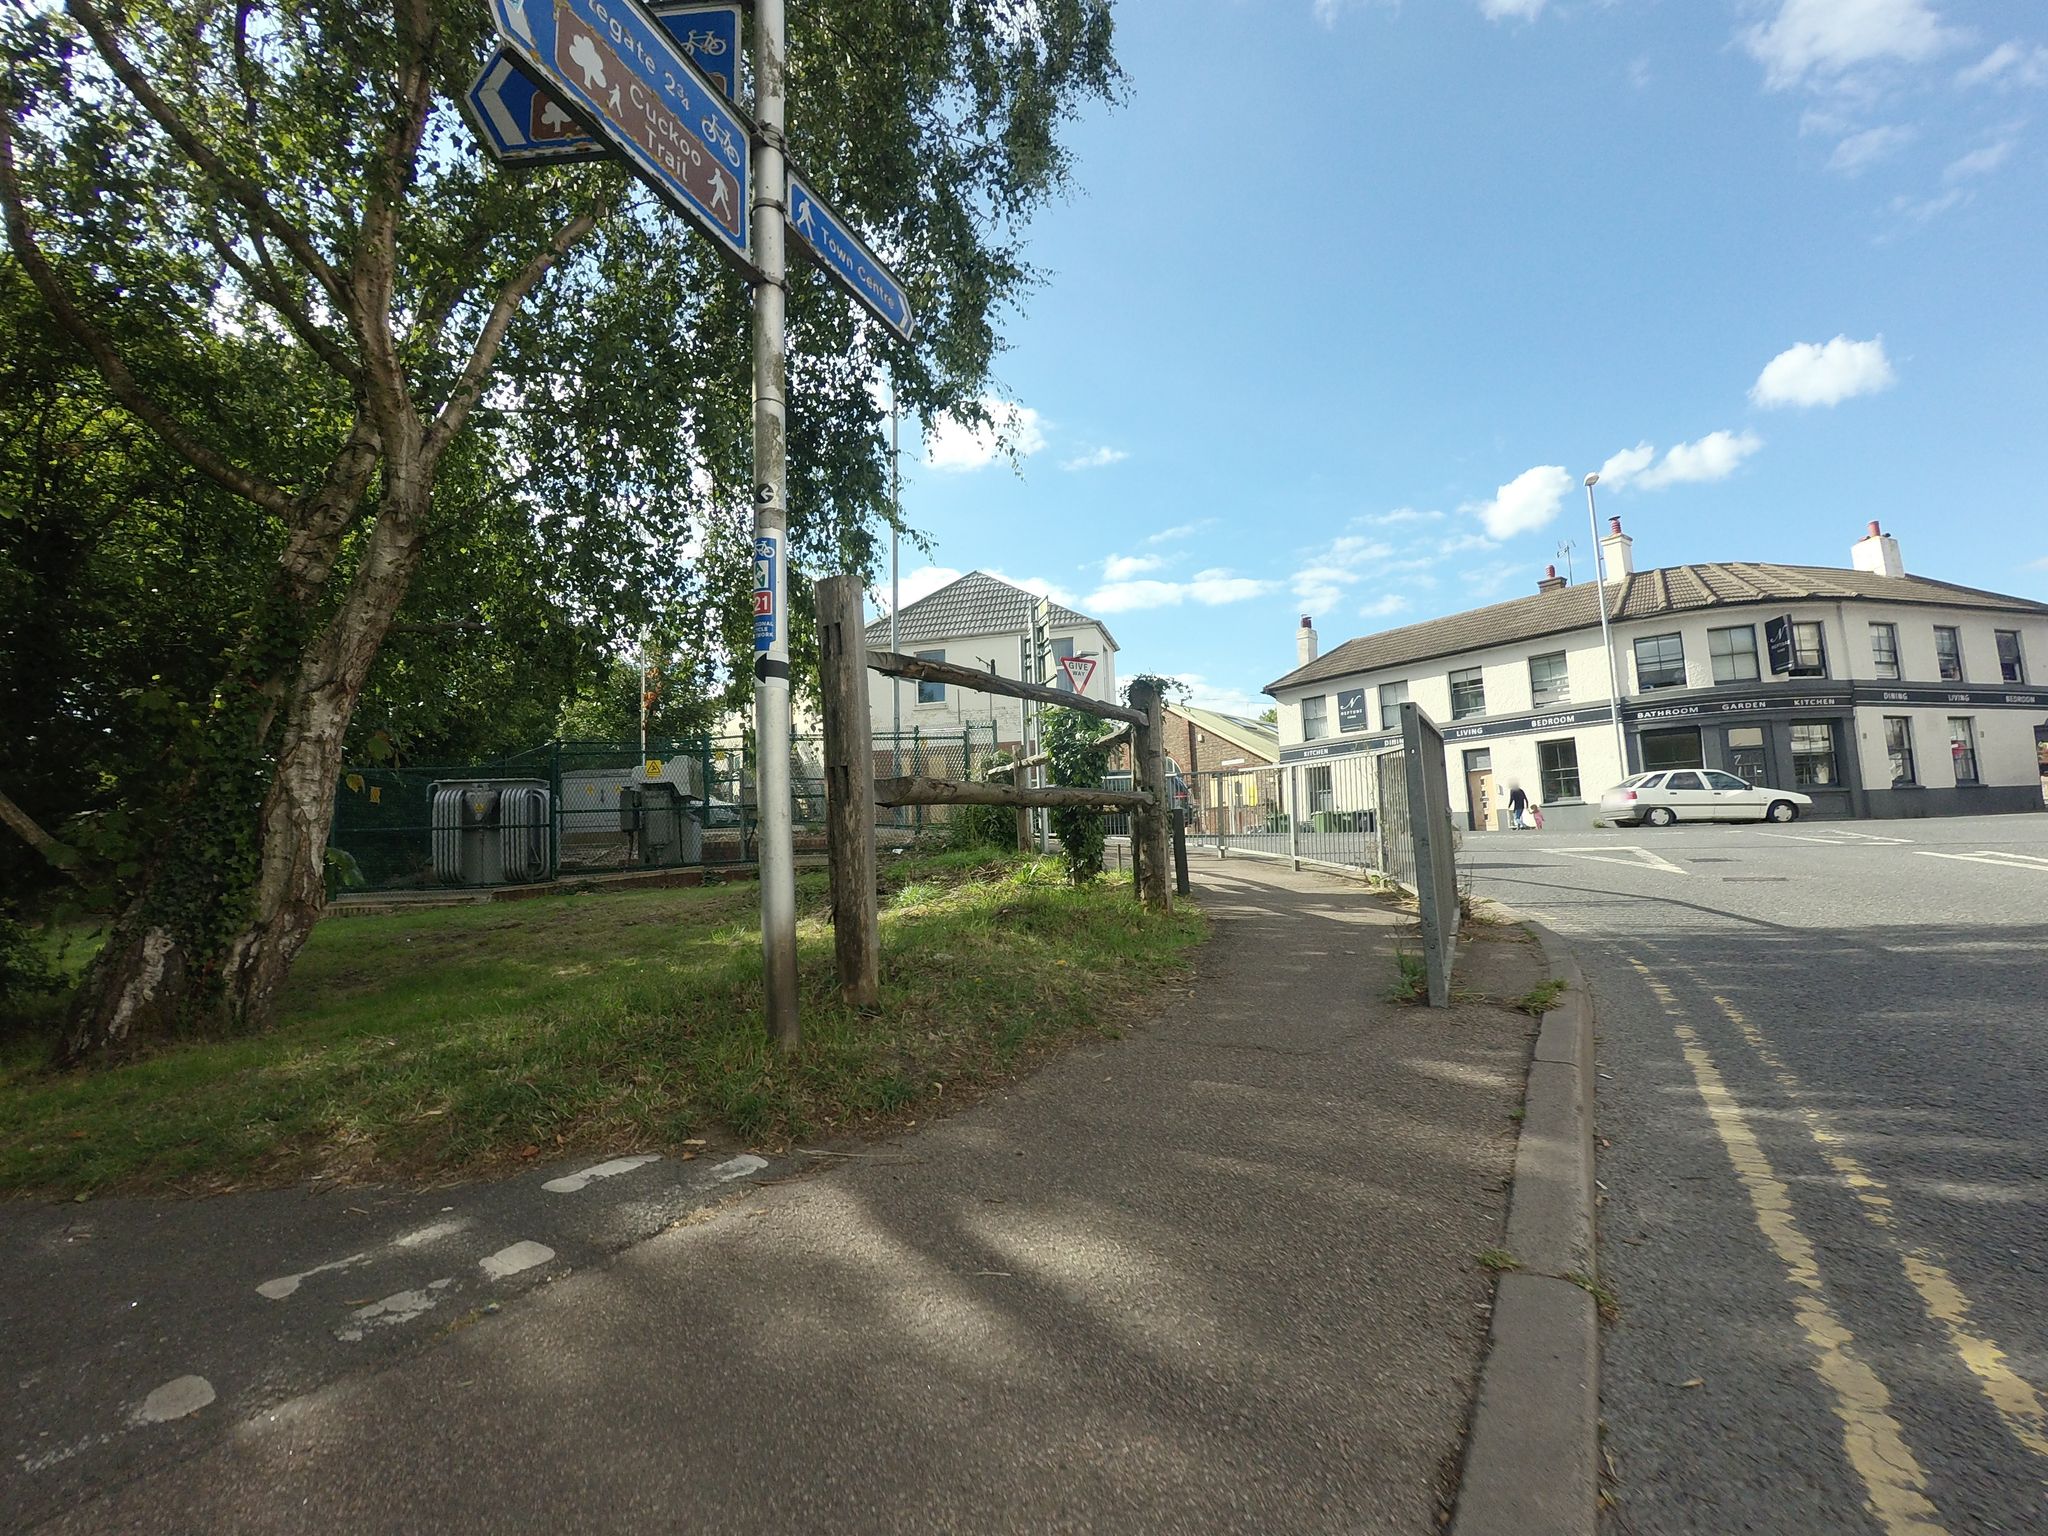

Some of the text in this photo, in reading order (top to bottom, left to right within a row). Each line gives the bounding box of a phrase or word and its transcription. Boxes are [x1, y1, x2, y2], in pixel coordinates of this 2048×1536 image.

[629, 84, 701, 167] Cuckoo
[644, 125, 688, 183] Trail
[821, 226, 895, 309] Town Centre
[754, 595, 767, 611] 21
[1069, 662, 1088, 671] GIVE
[1637, 698, 1835, 719] BATHROOM GARDEN KITCHEN
[1883, 692, 2036, 703] DINING LIVING BEDROOM
[1303, 715, 1575, 757] KITCHEN DININ LIVING BEDROOM
